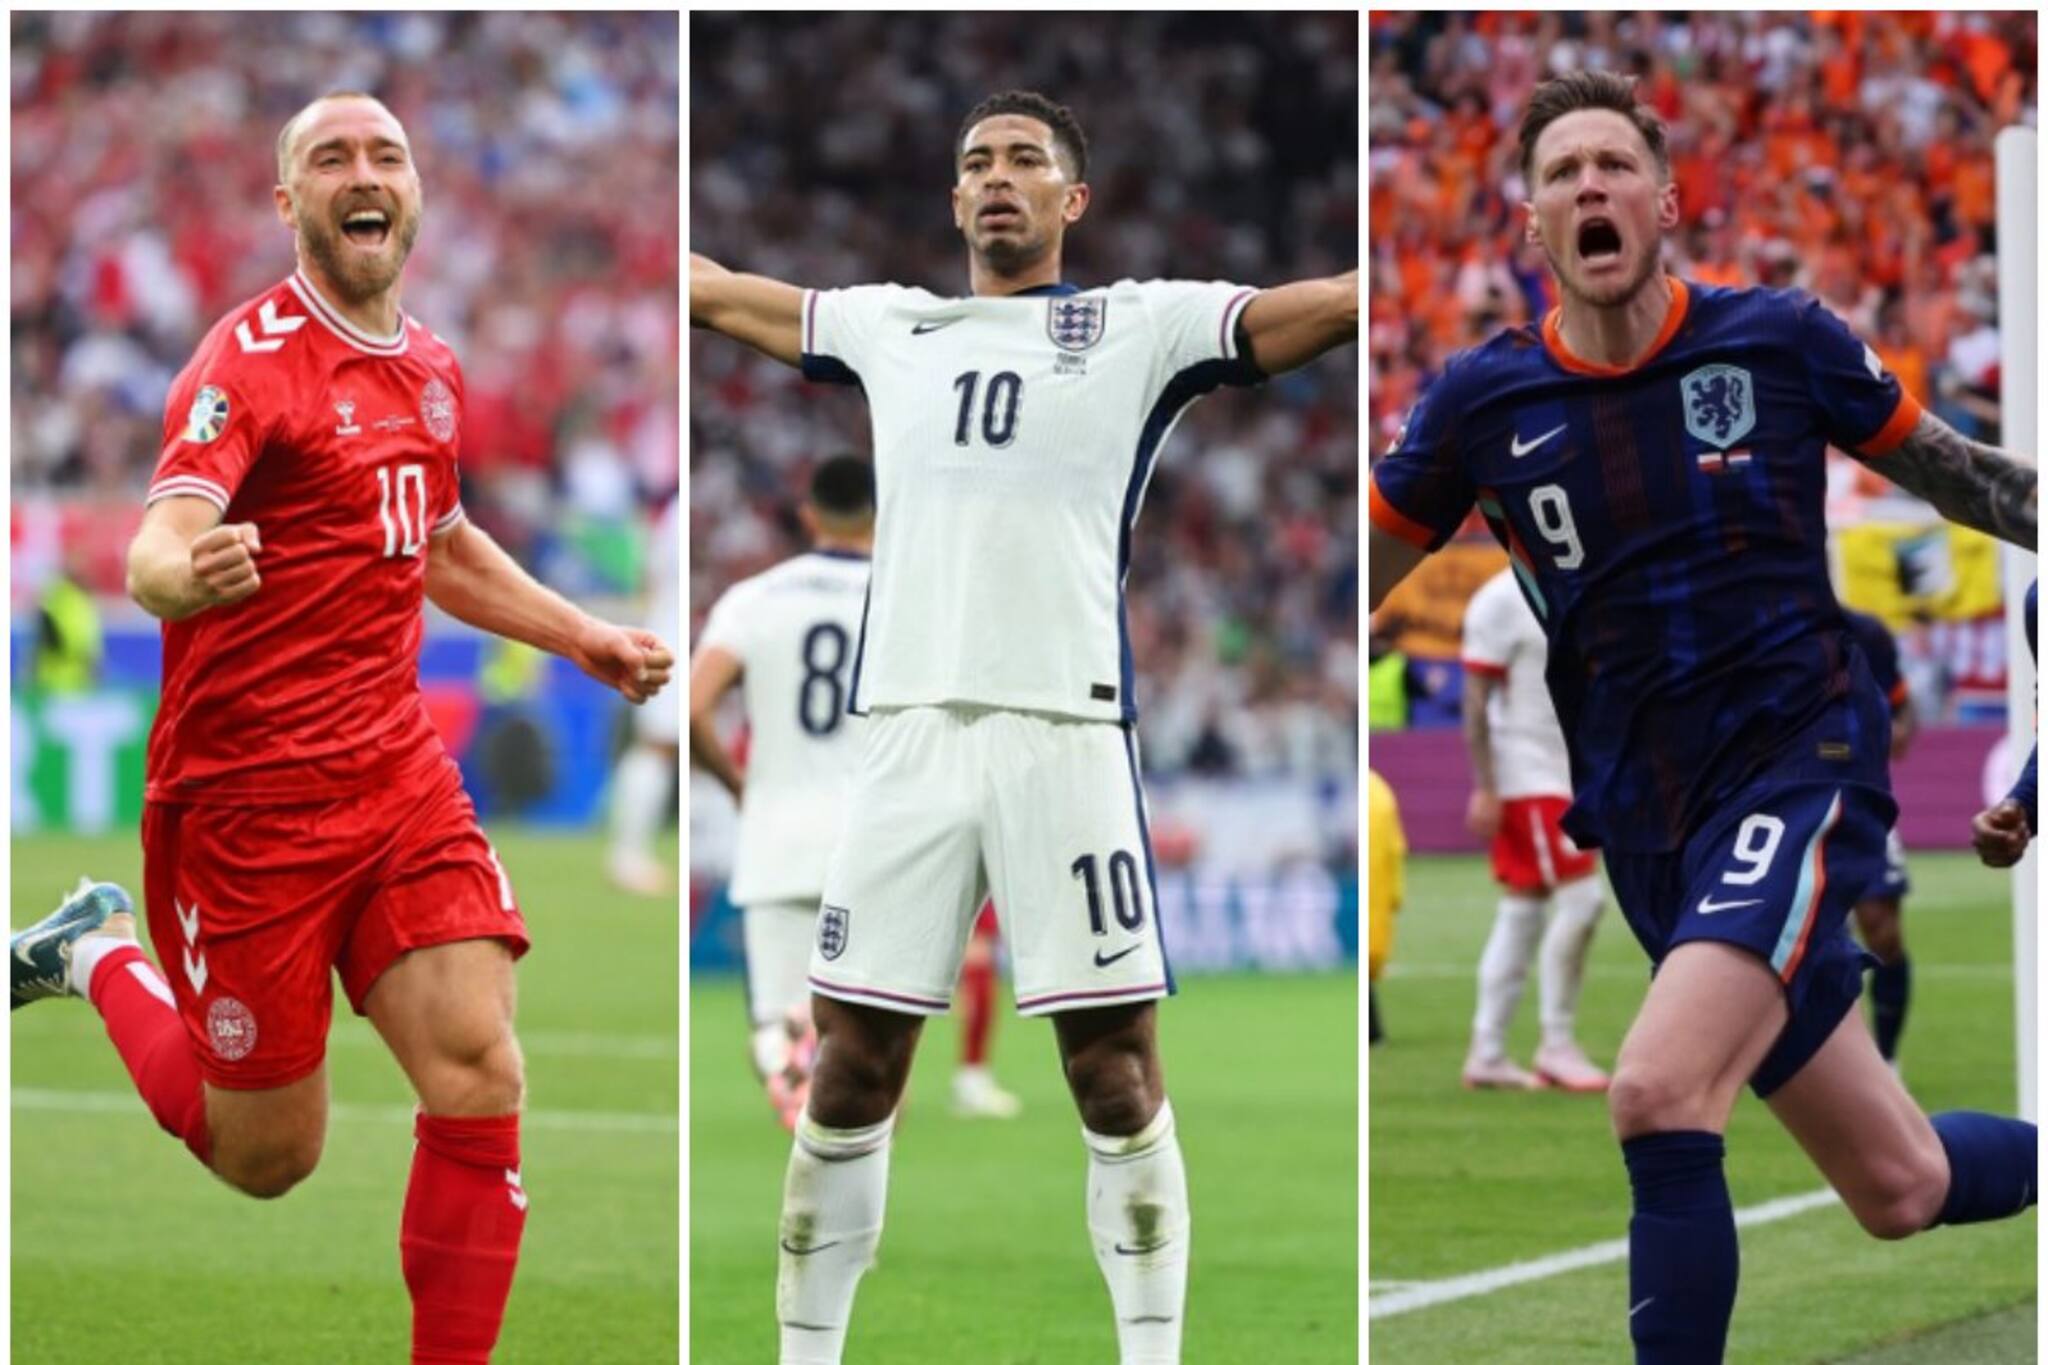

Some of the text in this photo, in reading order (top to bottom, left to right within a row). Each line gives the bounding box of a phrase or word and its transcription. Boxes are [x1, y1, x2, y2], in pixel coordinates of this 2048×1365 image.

[953, 370, 1024, 448] 10
[377, 463, 427, 558] 10
[1528, 484, 1584, 569] 9
[799, 620, 850, 738] 8
[1721, 814, 1785, 884] 9
[1071, 849, 1145, 936] 10
